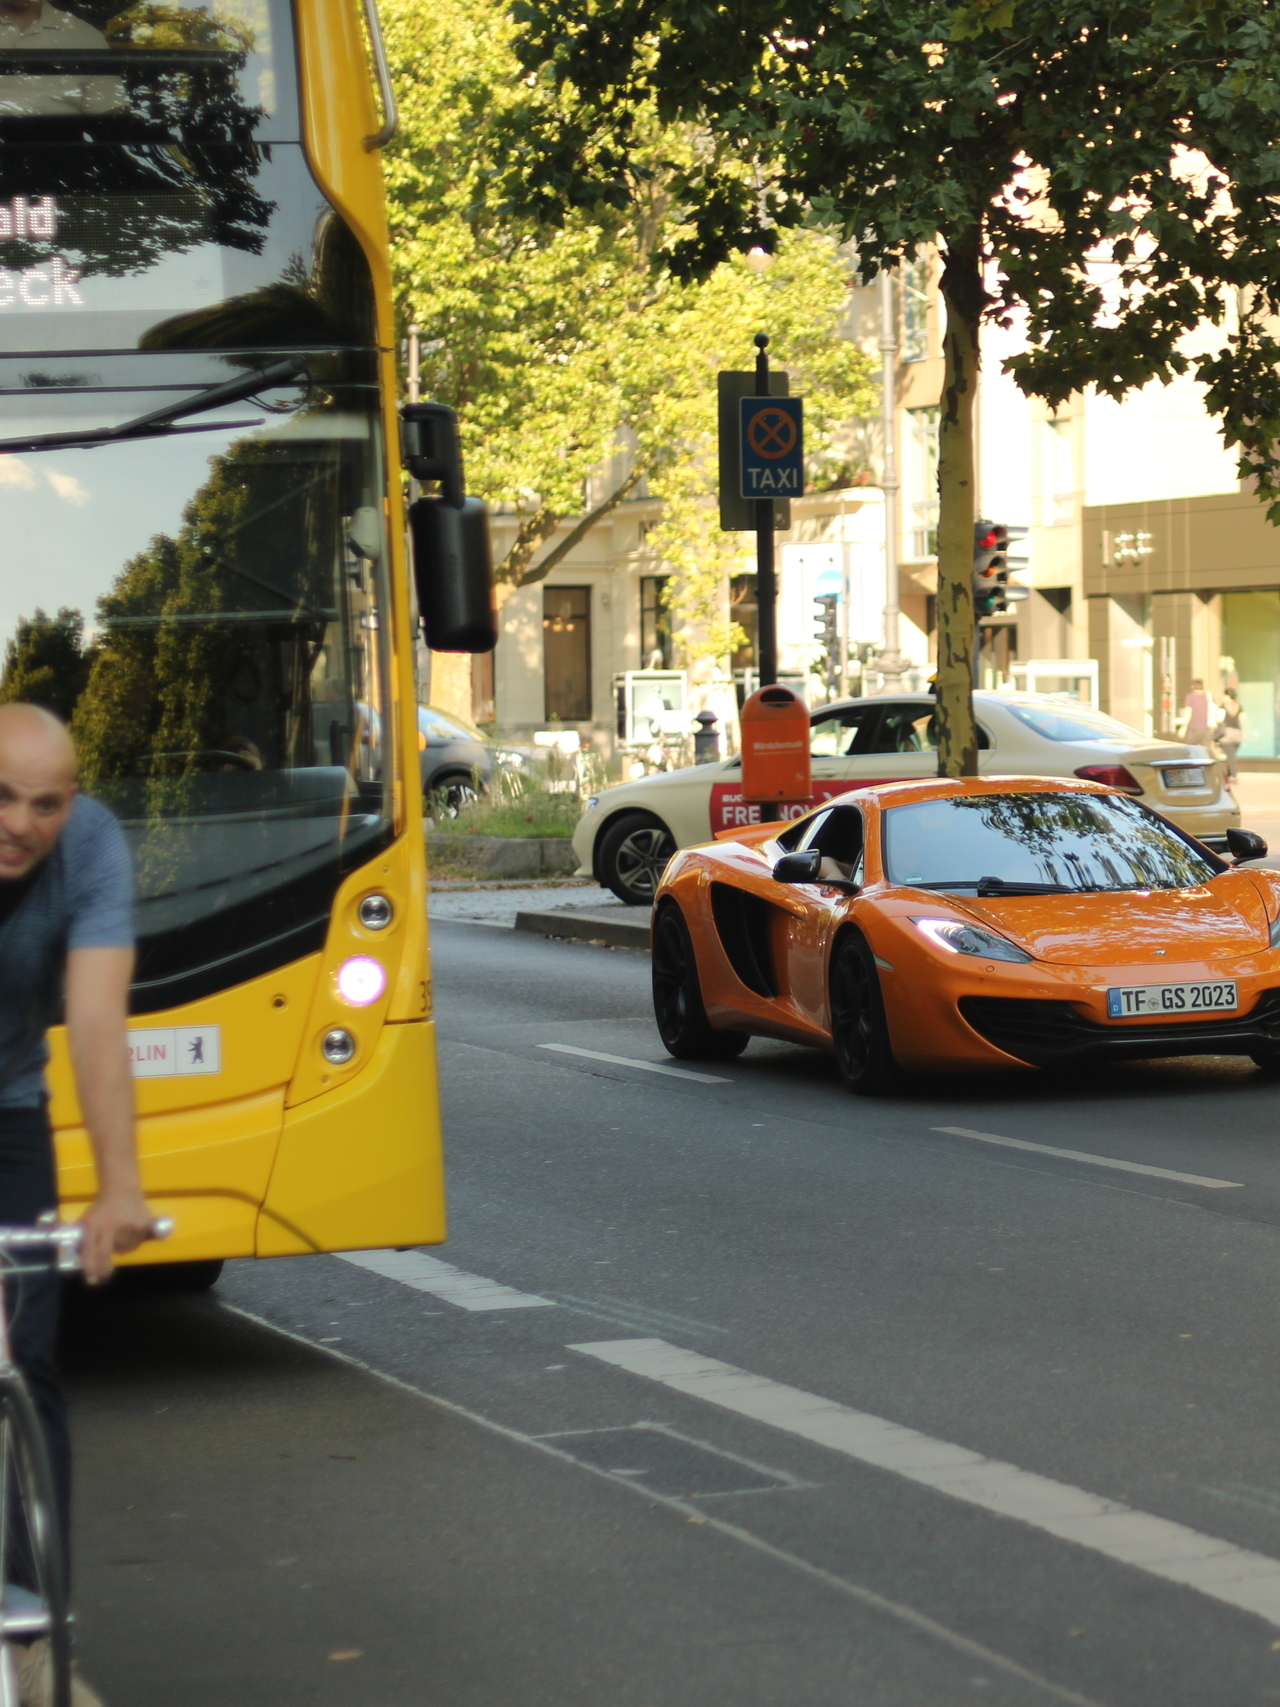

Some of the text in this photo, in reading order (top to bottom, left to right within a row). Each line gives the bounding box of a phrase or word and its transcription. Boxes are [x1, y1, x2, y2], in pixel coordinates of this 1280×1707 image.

[747, 468, 798, 489] TAXI
[1122, 984, 1235, 1012] TF GS 2023
